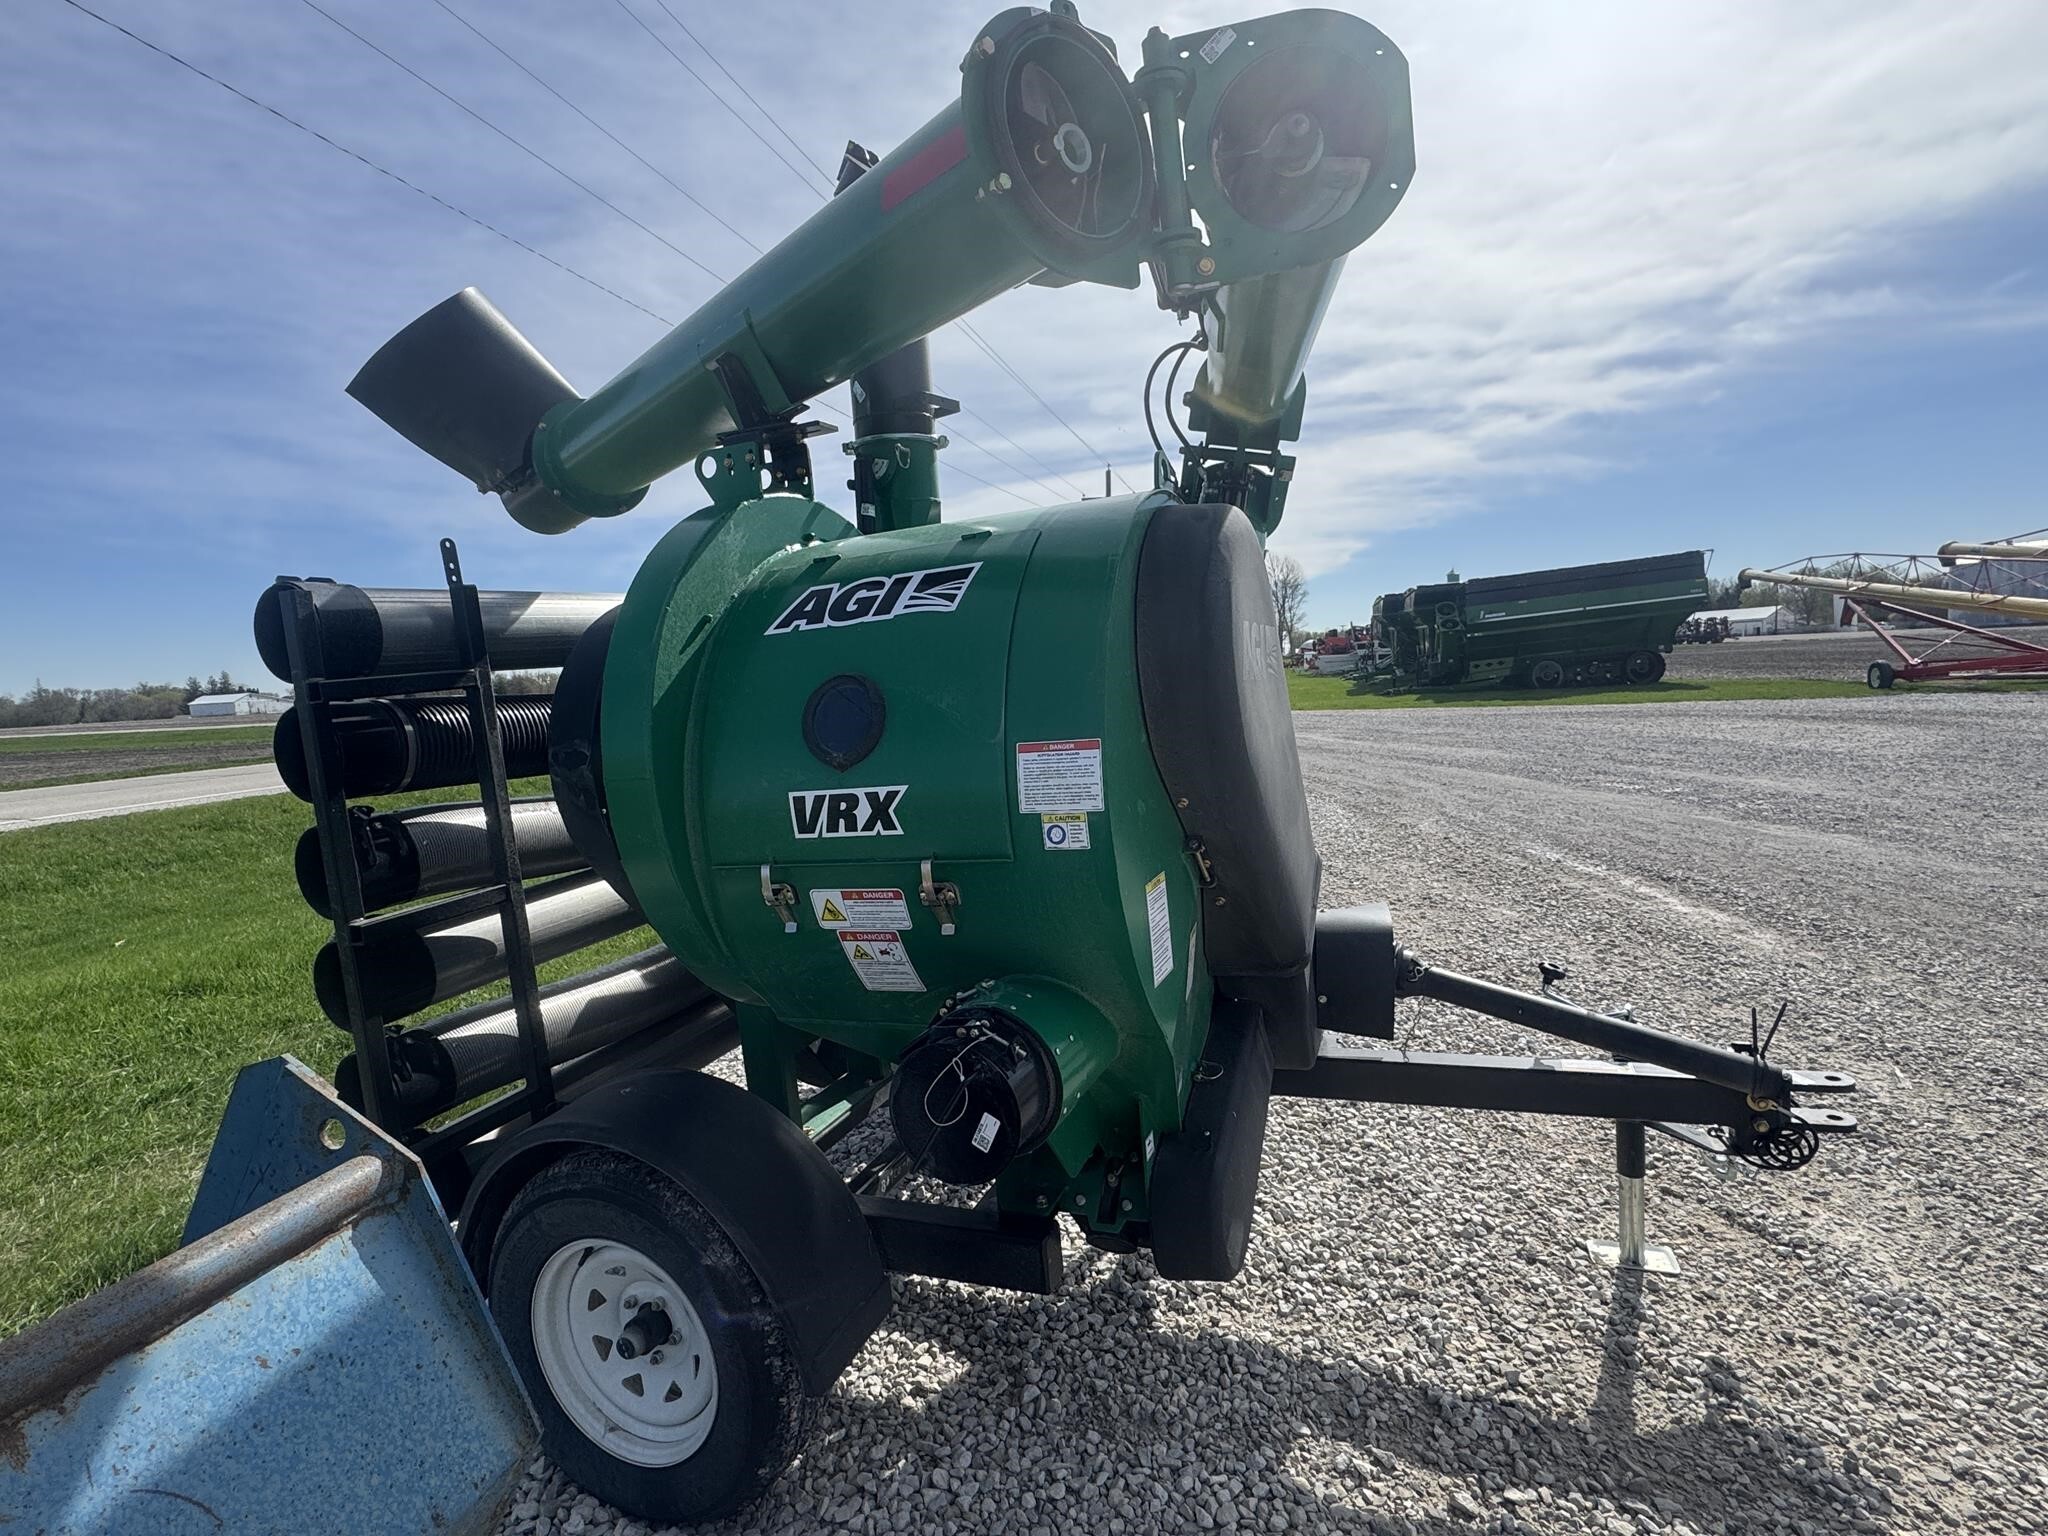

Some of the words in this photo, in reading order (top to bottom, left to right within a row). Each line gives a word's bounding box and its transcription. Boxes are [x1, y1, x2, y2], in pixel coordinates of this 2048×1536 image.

[769, 575, 914, 633] AGI
[1049, 743, 1075, 751] DANGER
[790, 788, 903, 836] VRX
